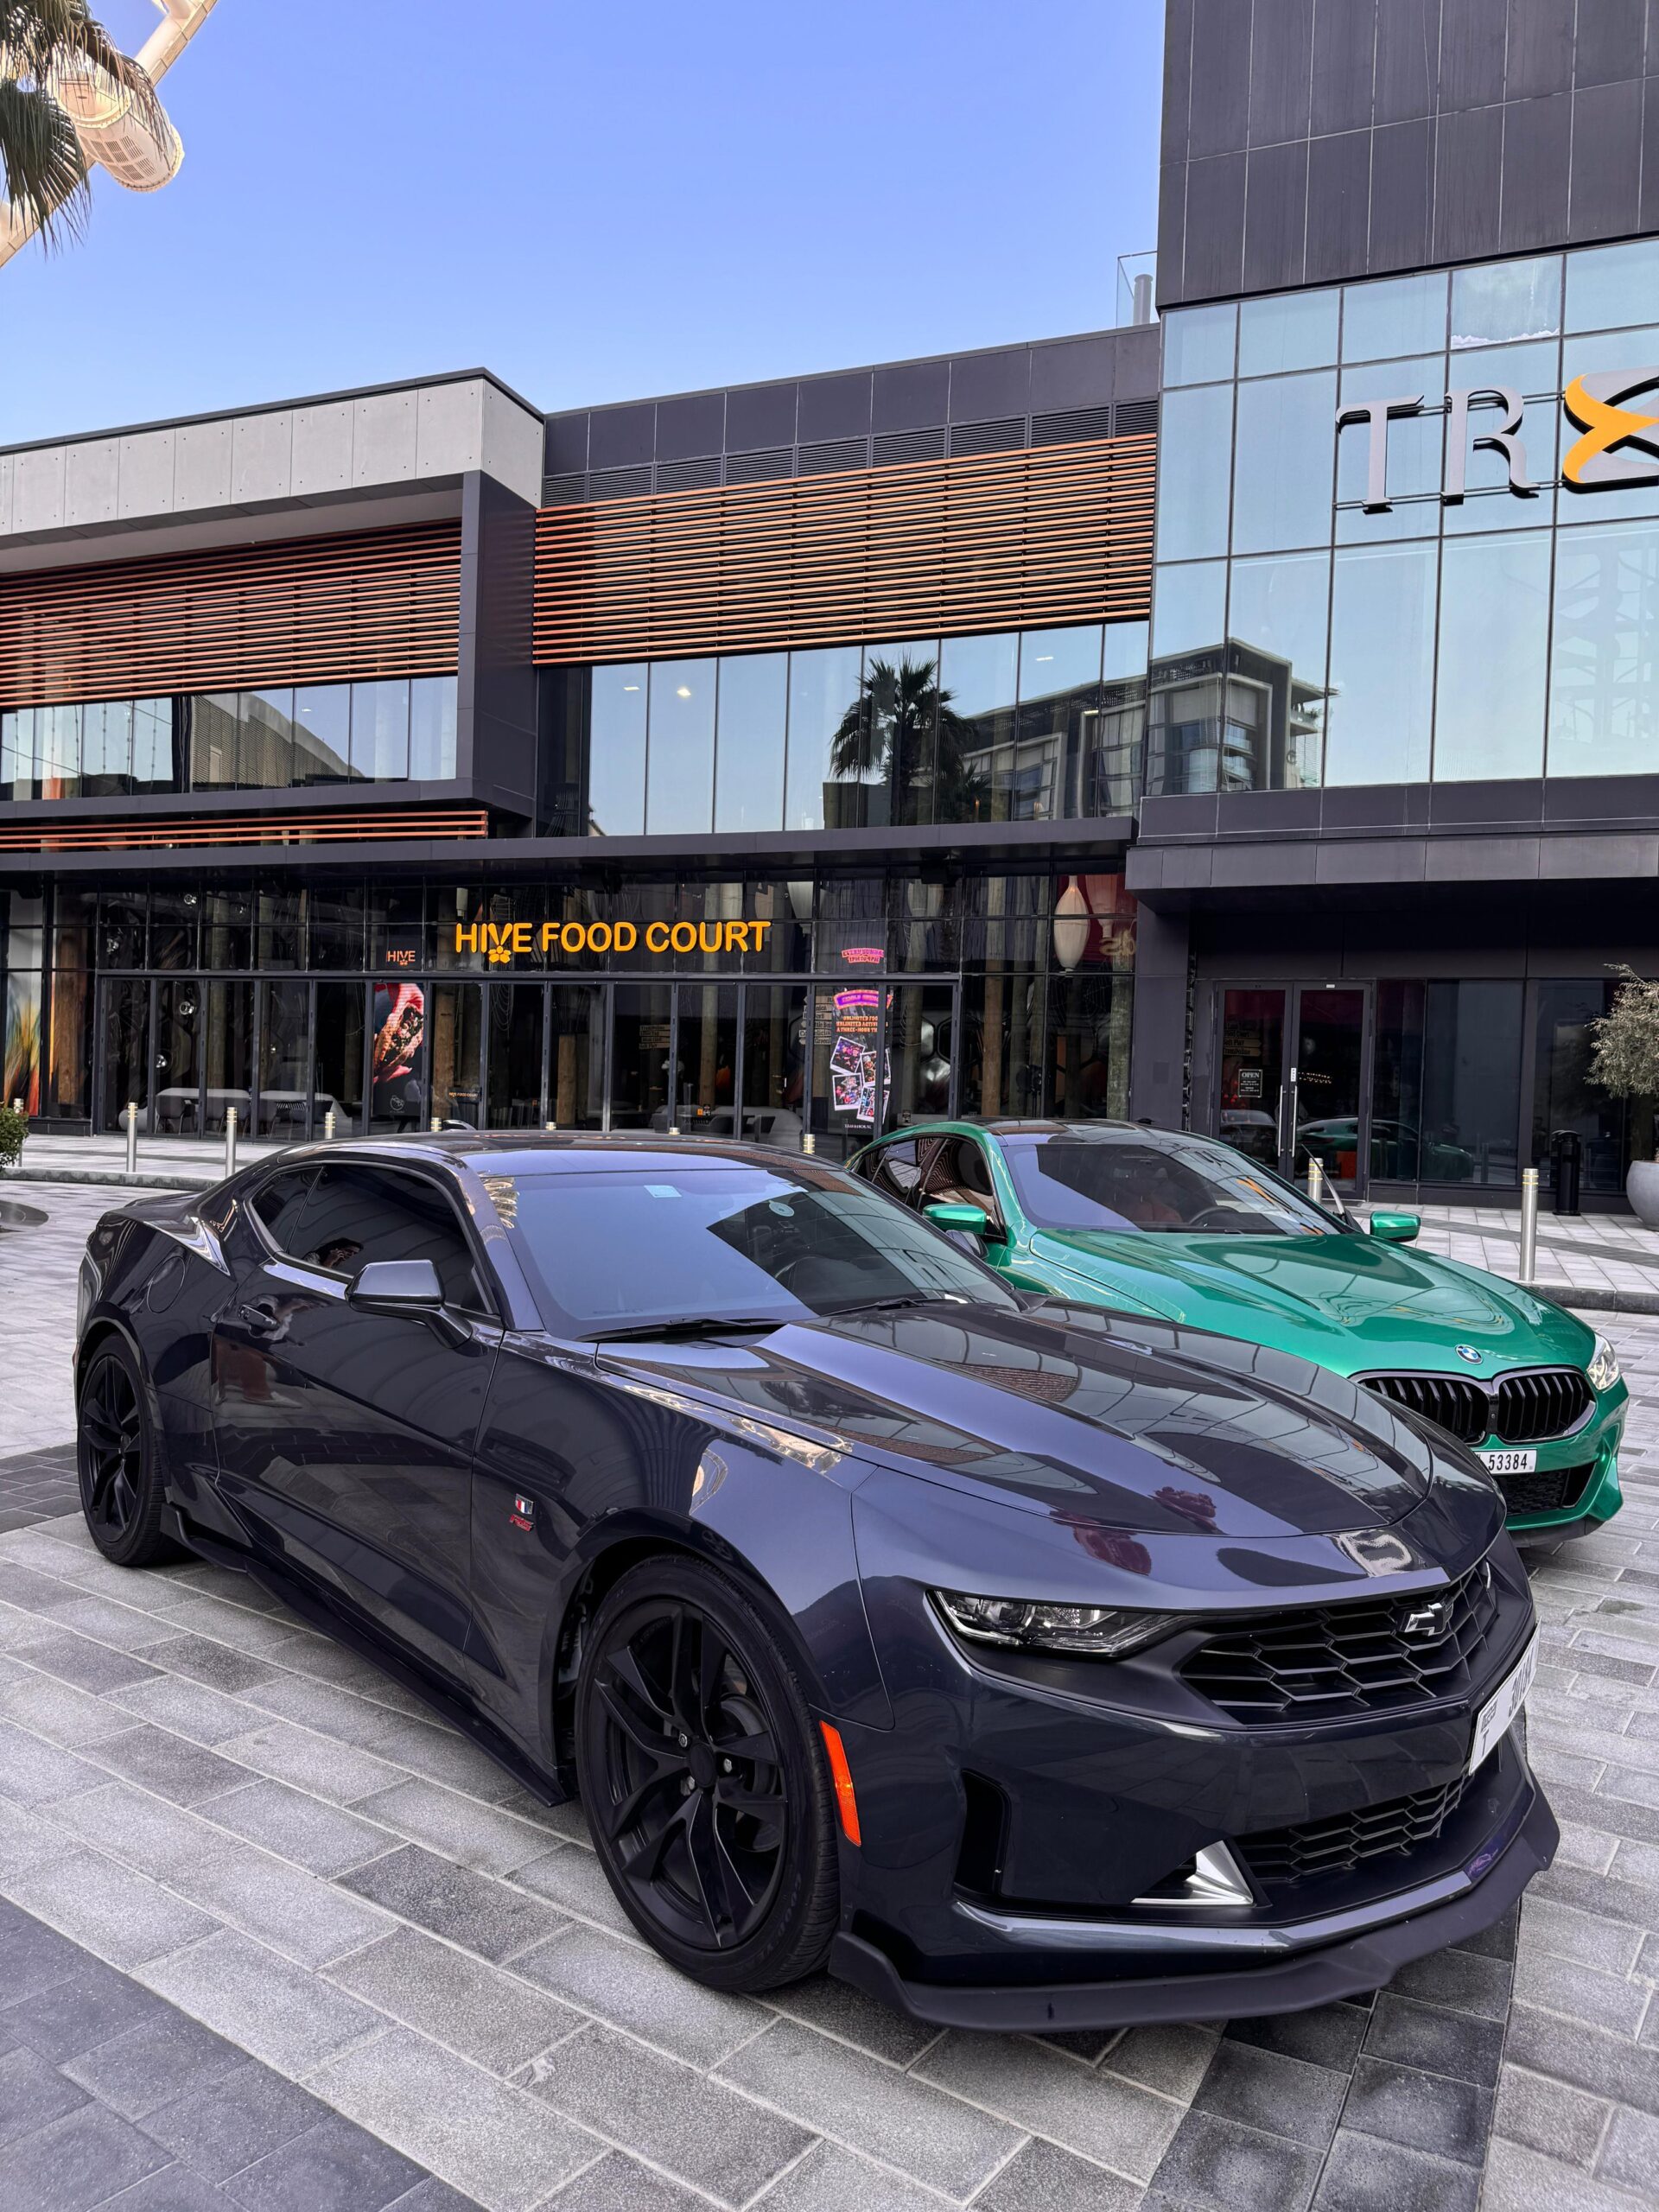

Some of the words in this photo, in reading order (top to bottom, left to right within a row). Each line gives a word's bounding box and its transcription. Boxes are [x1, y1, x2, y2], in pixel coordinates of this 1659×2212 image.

[455, 922, 533, 963] HIVE
[542, 921, 638, 952] FOOD
[645, 920, 772, 952] COURT
[387, 950, 416, 965] HIVE
[1488, 1453, 1528, 1471] 53384
